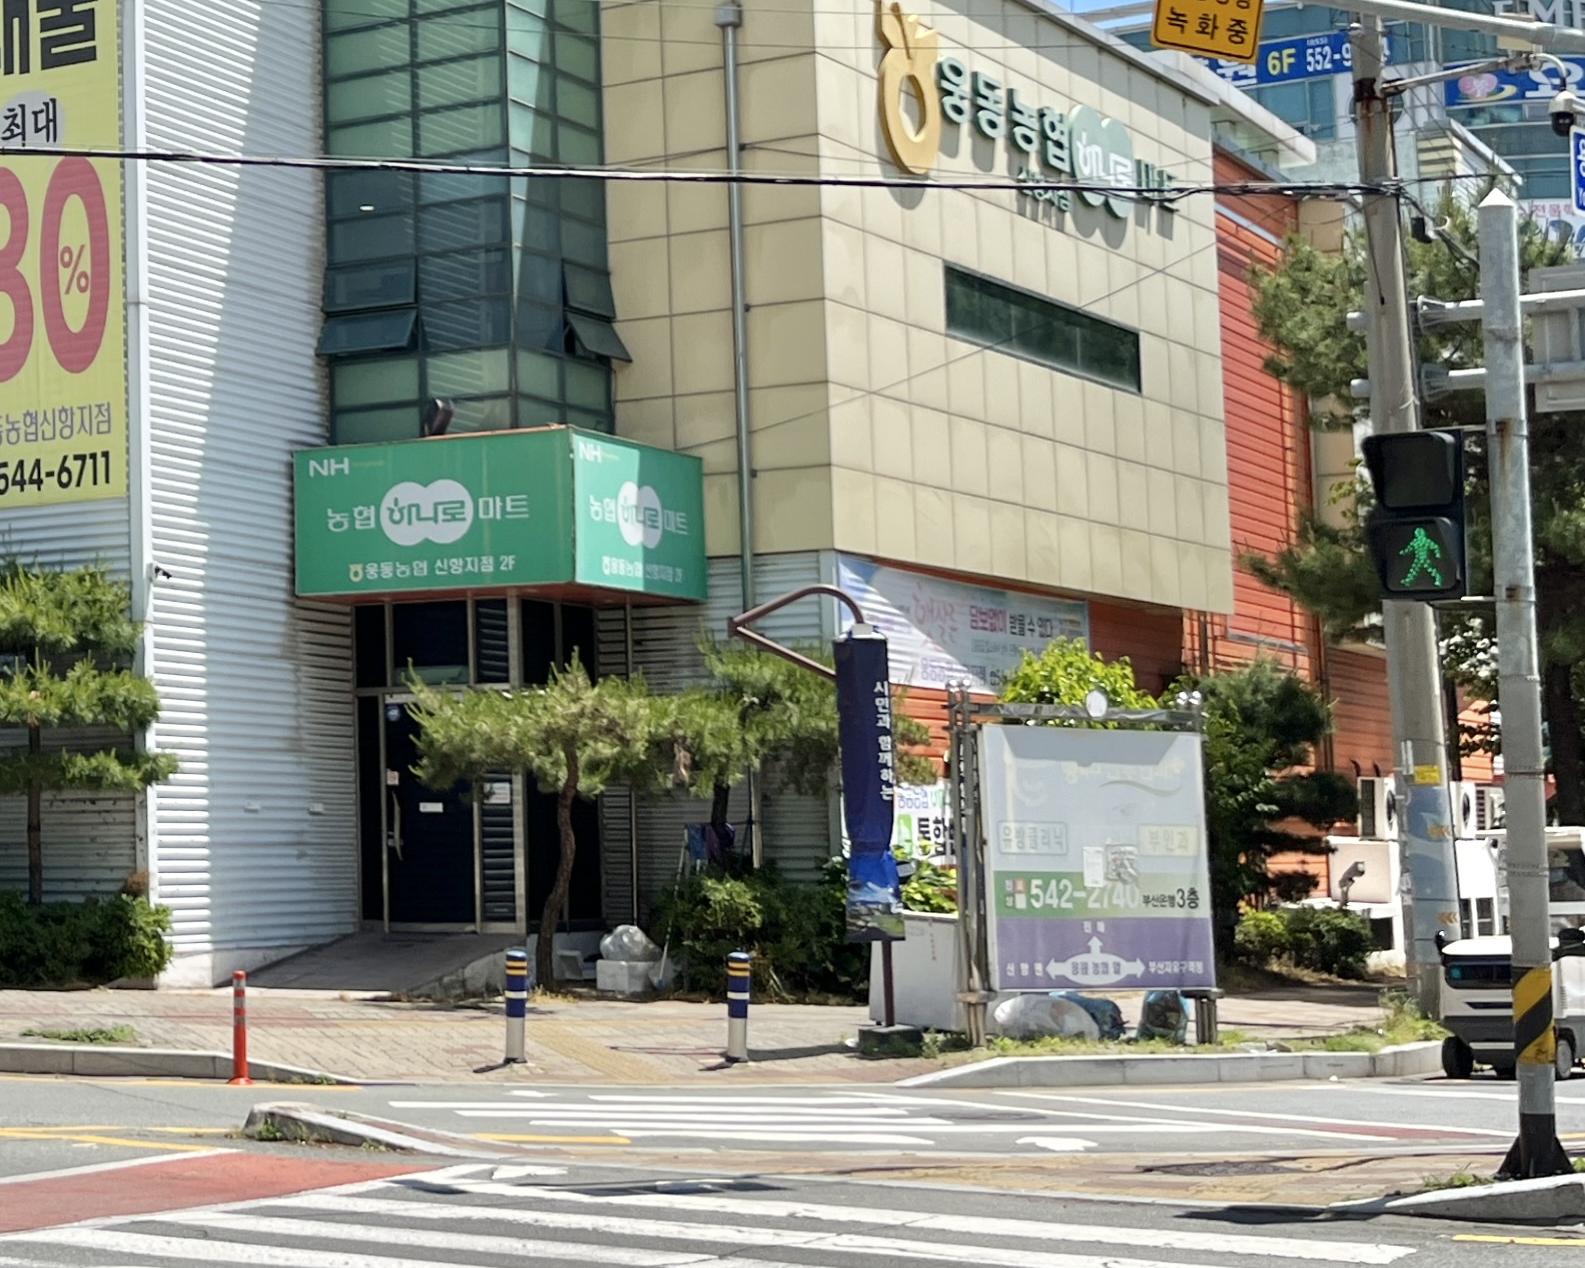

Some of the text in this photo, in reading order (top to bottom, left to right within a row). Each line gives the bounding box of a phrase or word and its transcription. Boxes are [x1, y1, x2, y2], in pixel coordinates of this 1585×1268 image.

[1267, 48, 1296, 76] 6F
[0, 96, 58, 148] 최대
[936, 56, 1071, 173] 웅동농협
[309, 457, 349, 478] NH
[578, 441, 603, 464] NH
[326, 494, 529, 532] 농협 하나로 마트
[589, 494, 616, 523] 농협
[663, 509, 688, 535] 마트
[434, 556, 494, 576] 신항지점
[499, 554, 516, 571] 2F
